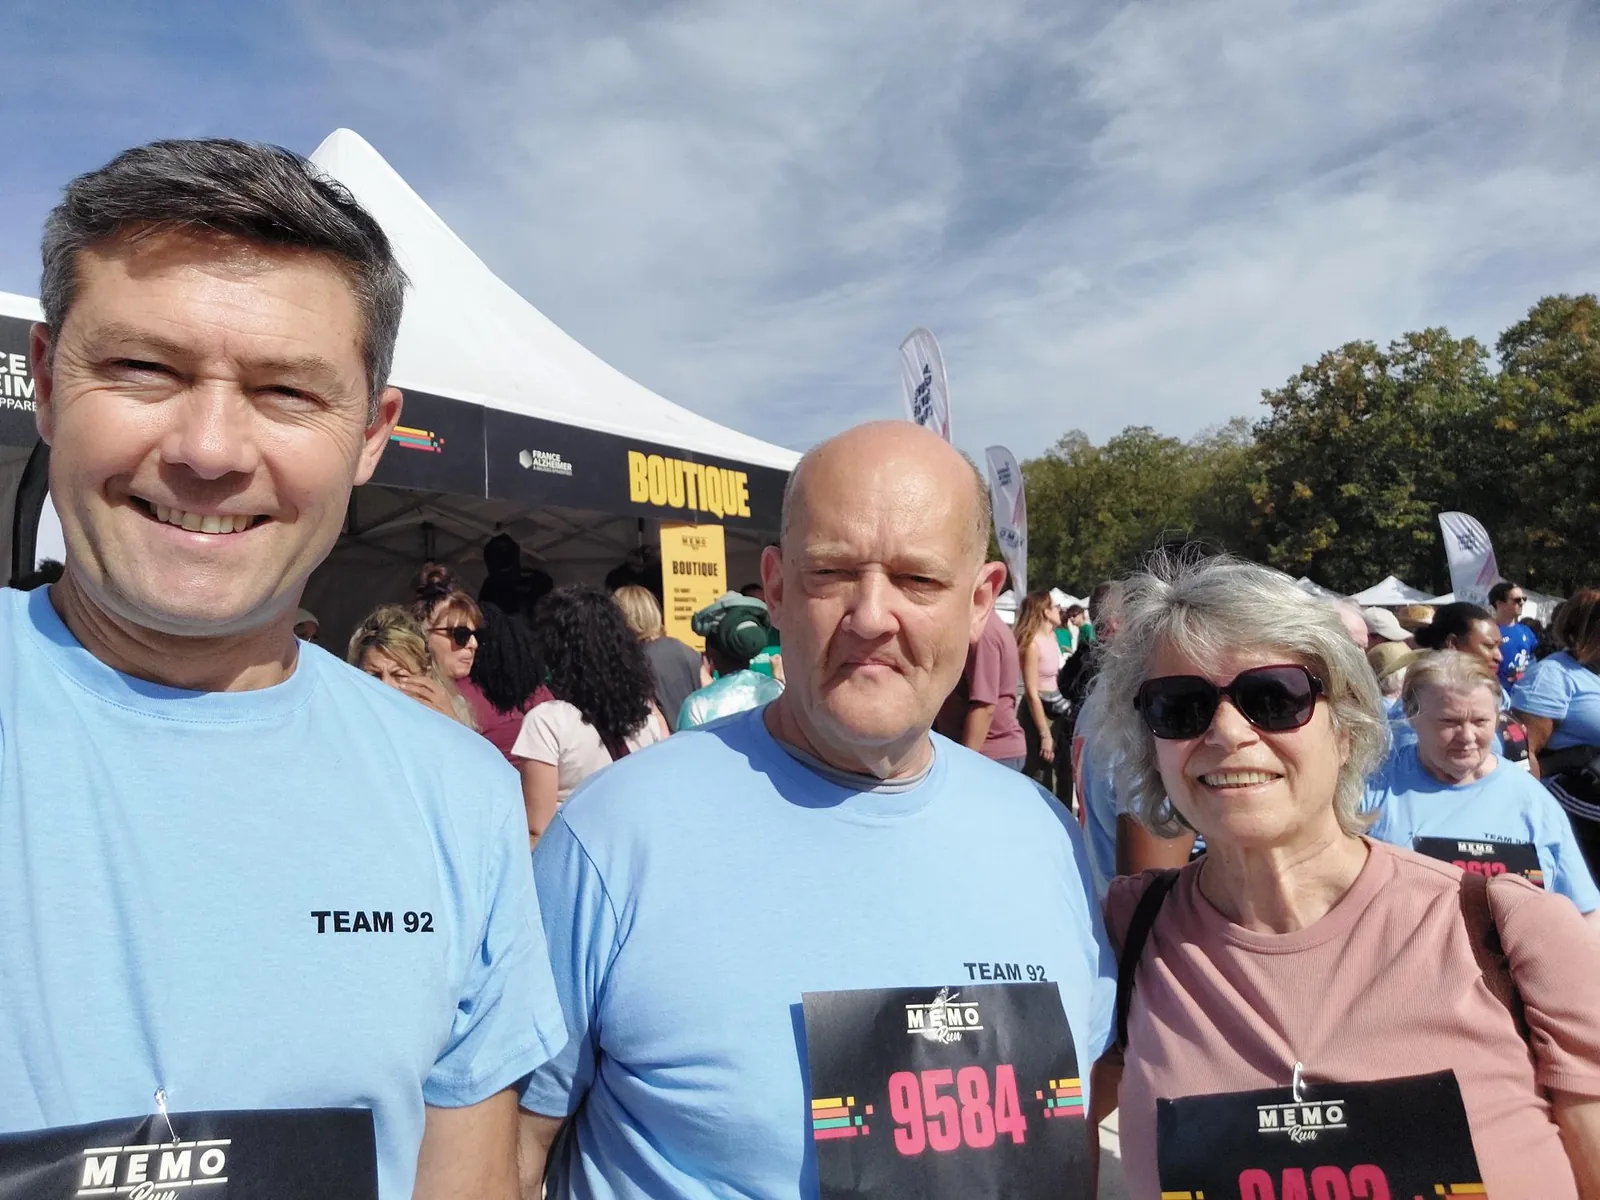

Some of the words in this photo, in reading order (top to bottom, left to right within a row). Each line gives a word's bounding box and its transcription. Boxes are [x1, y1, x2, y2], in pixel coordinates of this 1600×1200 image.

[533, 450, 560, 461] FRANCE
[533, 457, 572, 470] ALZHEIMER
[627, 450, 751, 519] BOUTIQUE
[672, 561, 719, 577] BOUTIQUE
[311, 911, 394, 933] TEAM
[403, 911, 435, 932] 92
[964, 962, 1022, 981] TEAM
[1027, 964, 1048, 982] 92
[907, 1008, 979, 1029] MEMO
[936, 1026, 962, 1043] Run
[888, 1063, 1028, 1156] 9584
[1258, 1105, 1343, 1127] MEMO
[1288, 1124, 1317, 1143] Run
[82, 1148, 226, 1187] MEMO
